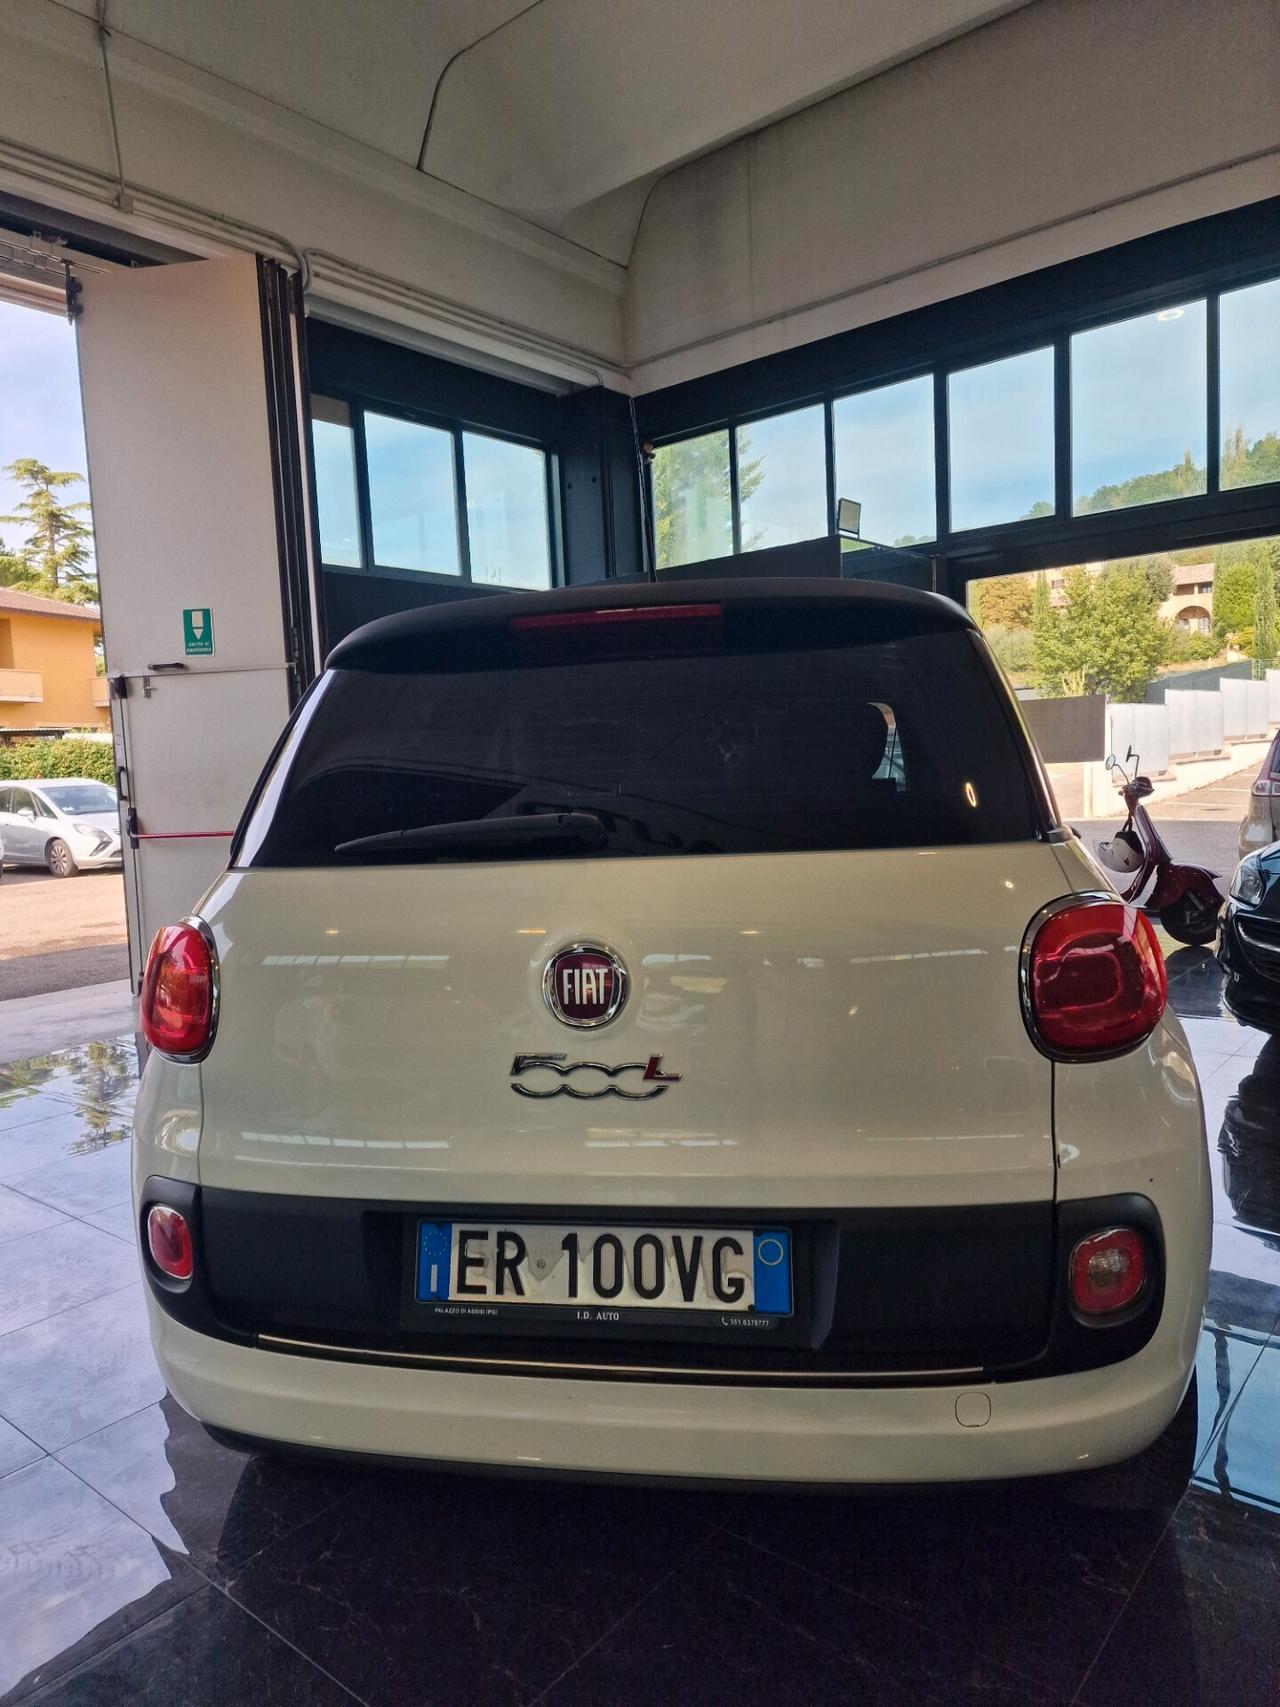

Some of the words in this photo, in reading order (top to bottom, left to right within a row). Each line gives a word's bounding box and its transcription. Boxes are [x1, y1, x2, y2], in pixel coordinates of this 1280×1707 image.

[562, 968, 609, 1005] FIAT
[510, 1053, 683, 1100] 500L
[457, 1230, 526, 1296] ER
[561, 1232, 745, 1303] 100VG
[577, 1311, 592, 1320] I.D.
[596, 1311, 620, 1321] AUTO
